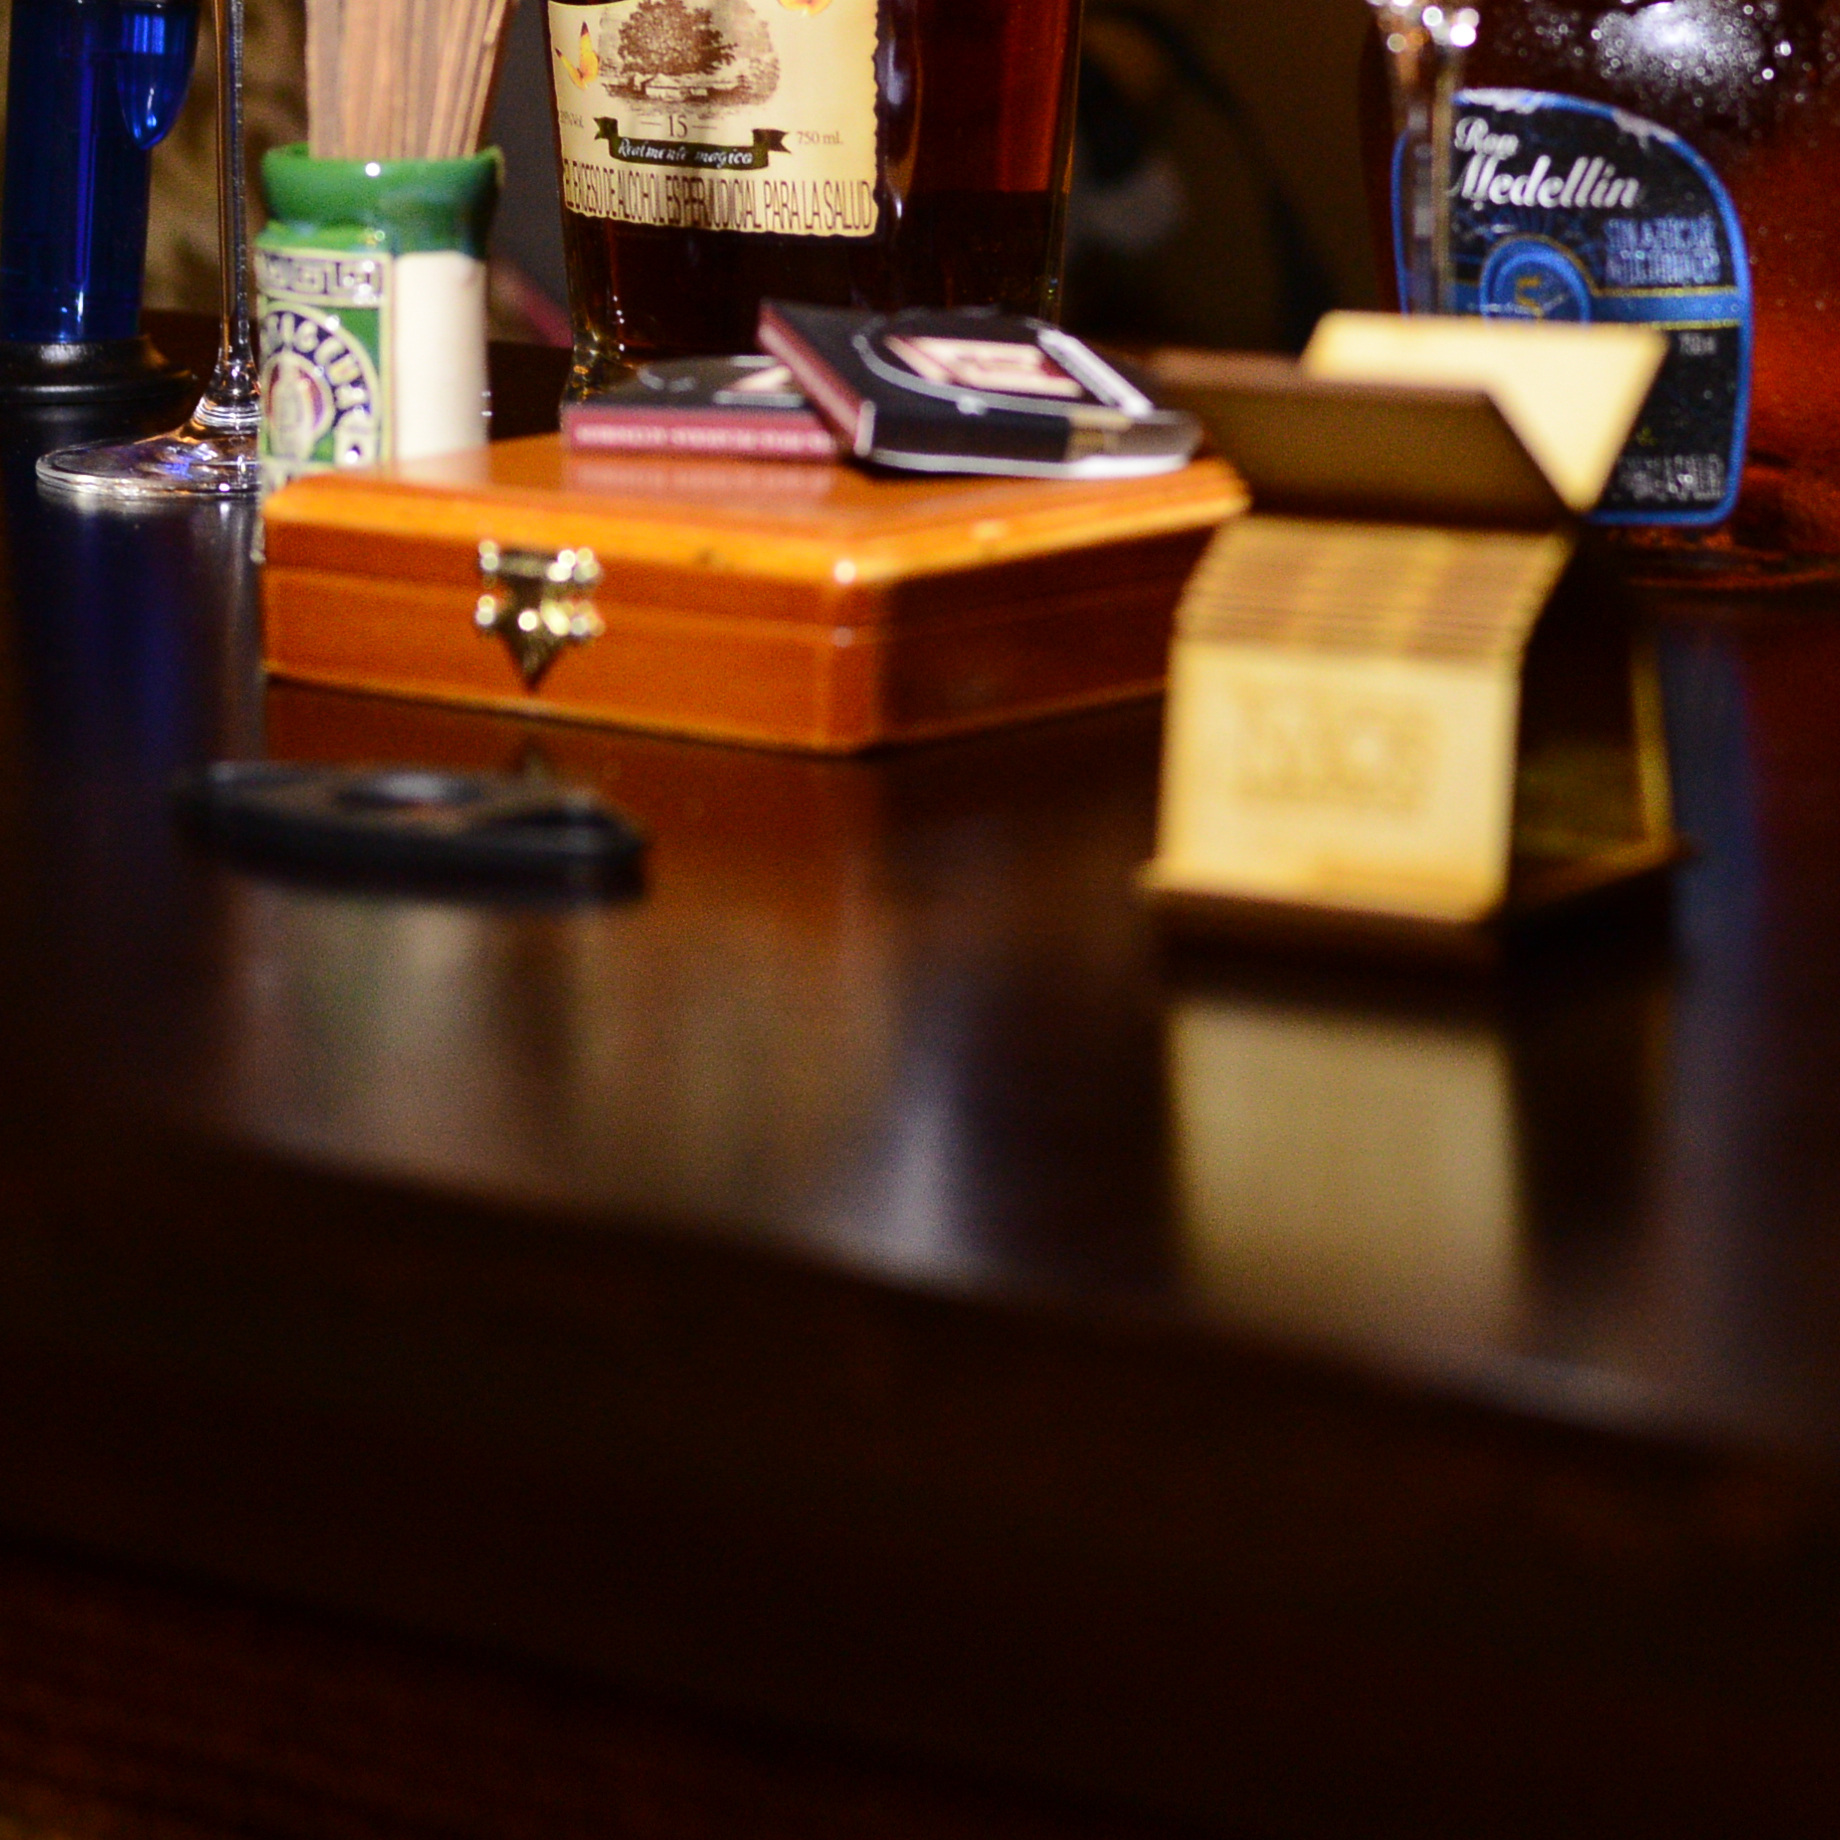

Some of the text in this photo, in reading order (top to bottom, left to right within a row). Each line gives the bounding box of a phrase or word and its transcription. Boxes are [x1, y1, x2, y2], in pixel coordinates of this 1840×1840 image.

[668, 114, 688, 138] 15
[796, 131, 820, 145] 750
[1454, 117, 1519, 158] Ron
[603, 167, 617, 218] DE
[618, 170, 665, 224] ALCOHOL
[666, 175, 681, 225] ES
[681, 175, 761, 229] PERJUDICIAL
[764, 180, 801, 230] PARA
[803, 181, 822, 230] LA
[823, 180, 872, 230] SALUD
